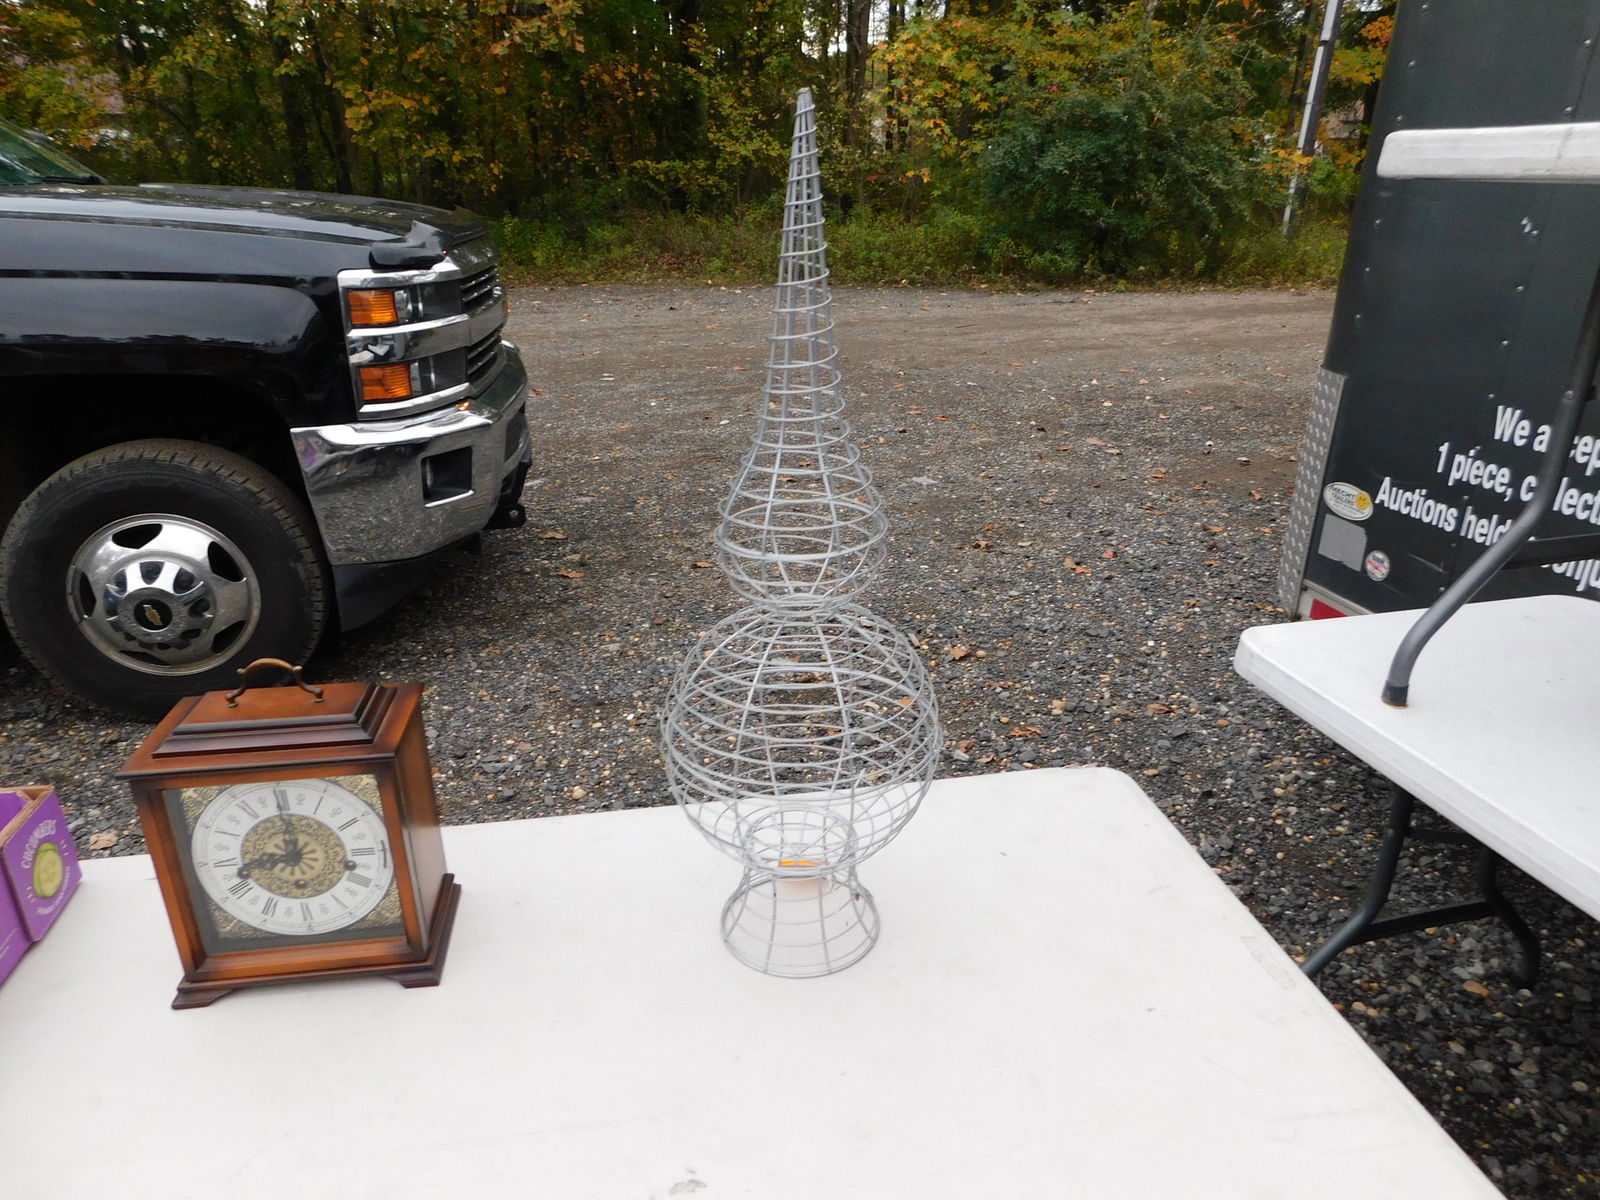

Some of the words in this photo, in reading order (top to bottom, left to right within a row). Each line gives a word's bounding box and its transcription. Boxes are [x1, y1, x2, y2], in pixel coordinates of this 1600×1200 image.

[1493, 405, 1530, 447] We
[1436, 442, 1450, 473] 1
[1447, 450, 1515, 502] piece,
[1375, 476, 1459, 532] Auctions
